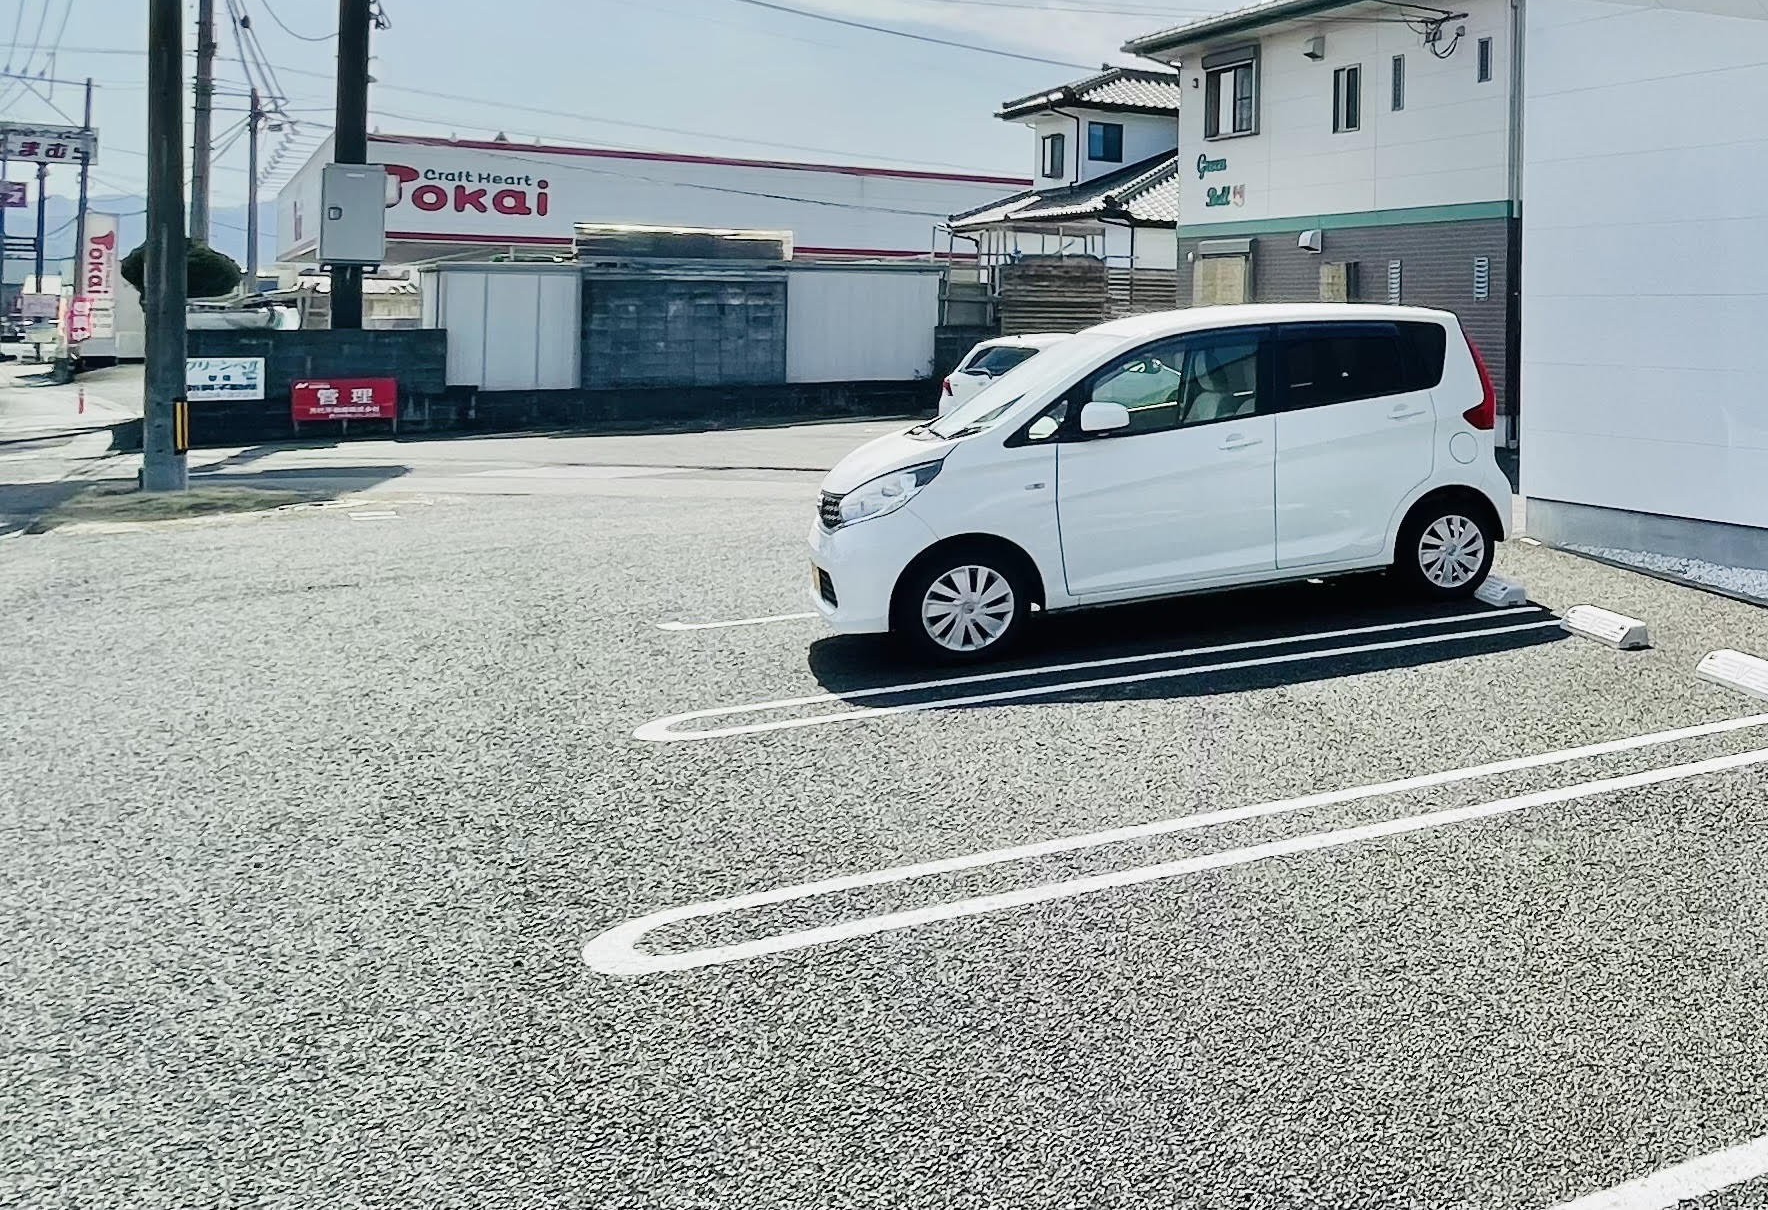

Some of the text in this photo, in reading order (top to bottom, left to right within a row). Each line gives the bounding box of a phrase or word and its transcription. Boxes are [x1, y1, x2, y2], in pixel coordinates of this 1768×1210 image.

[423, 168, 532, 187] Craft Heart
[88, 230, 115, 294] Tokai
